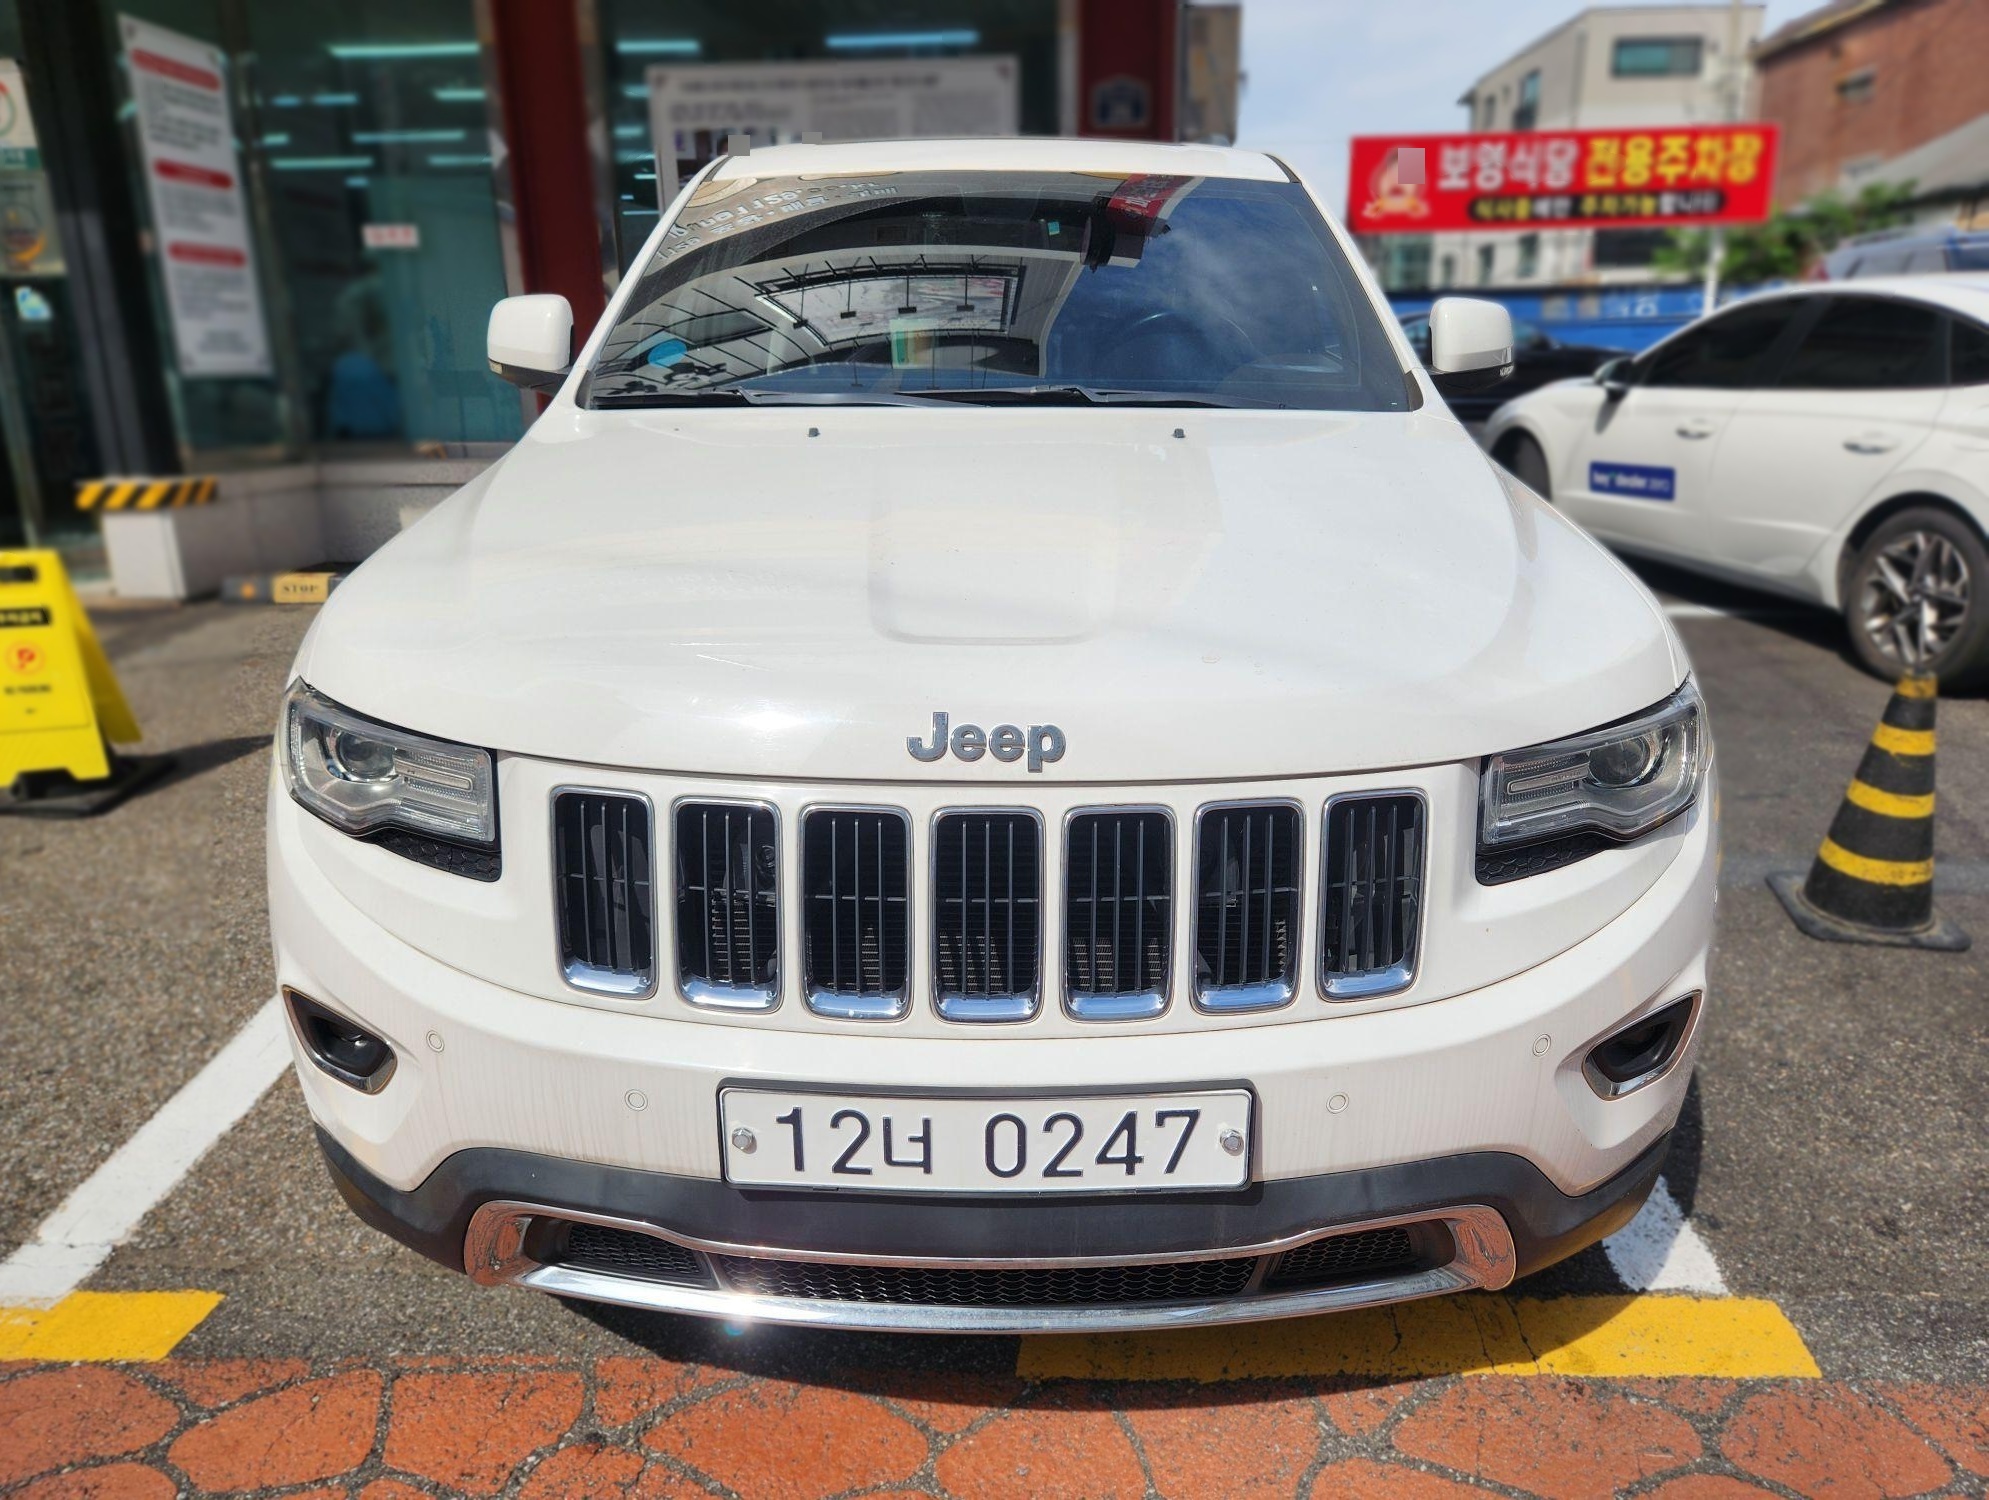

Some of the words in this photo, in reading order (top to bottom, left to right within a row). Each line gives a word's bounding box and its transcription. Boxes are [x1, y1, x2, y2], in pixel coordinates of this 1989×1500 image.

[1587, 135, 1761, 187] 전용주차장
[907, 712, 1066, 773] Jeep
[776, 1106, 933, 1175] 12너
[984, 1108, 1202, 1179] 0247
